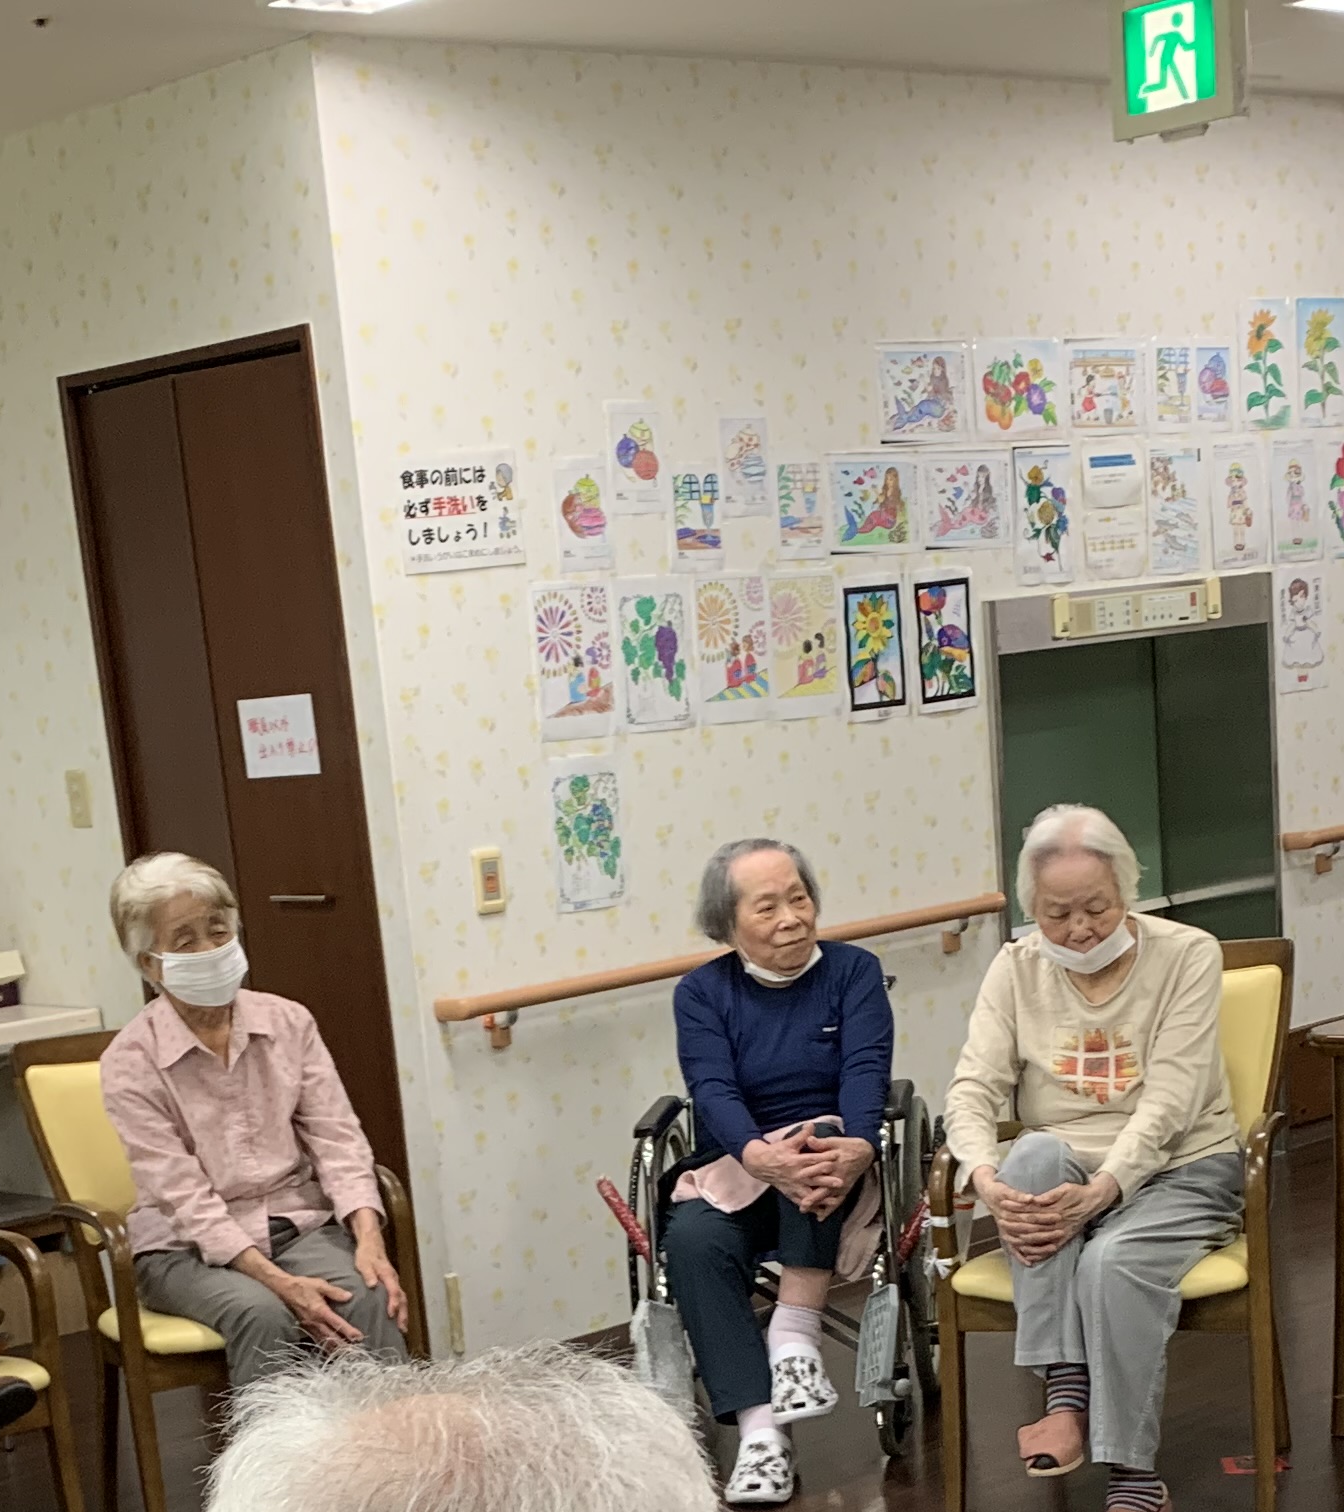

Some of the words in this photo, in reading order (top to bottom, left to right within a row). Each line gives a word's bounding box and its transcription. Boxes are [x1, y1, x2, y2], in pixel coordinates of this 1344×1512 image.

[400, 466, 486, 490] 食事の前には
[403, 495, 488, 519] 必ず手洗いを
